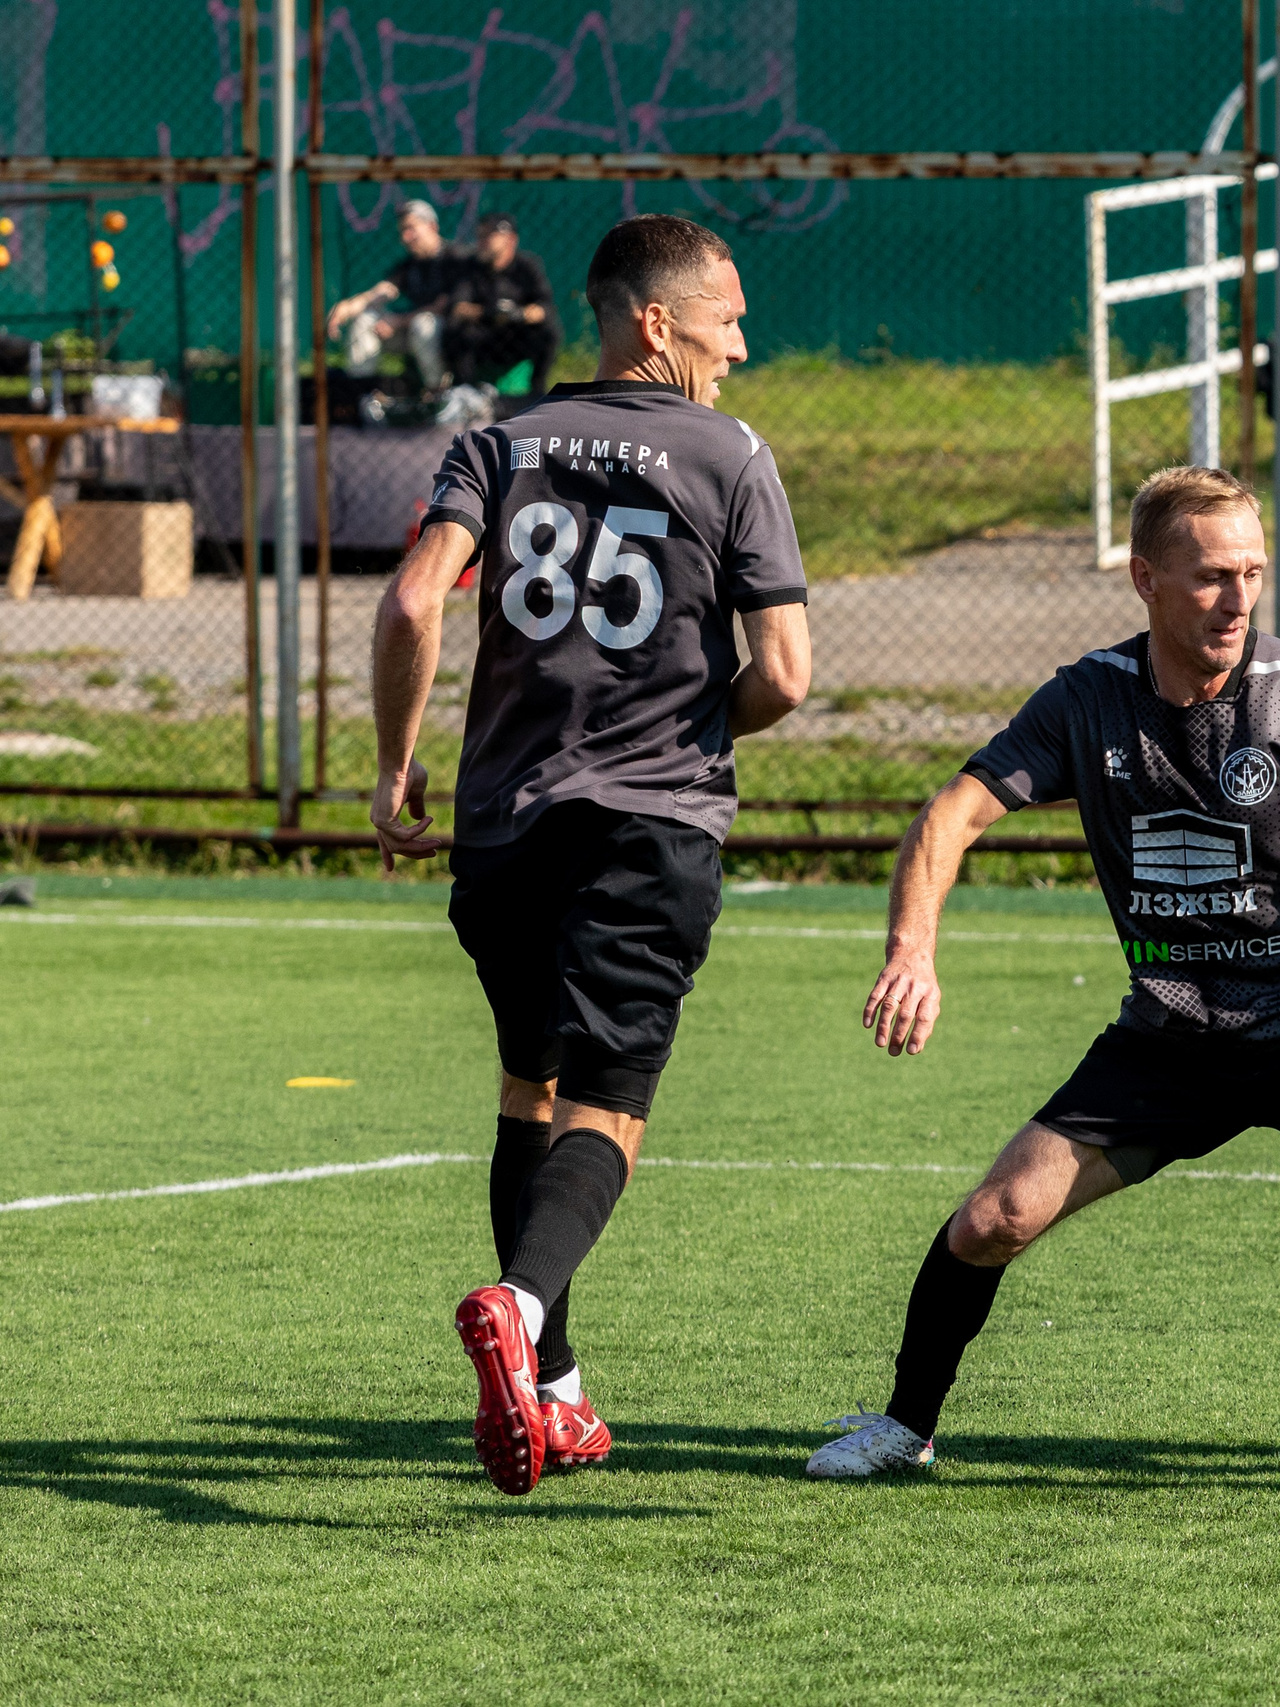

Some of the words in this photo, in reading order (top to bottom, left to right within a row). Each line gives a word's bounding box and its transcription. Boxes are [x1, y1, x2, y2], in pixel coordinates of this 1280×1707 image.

[548, 436, 669, 470] РИМЕРА
[570, 459, 647, 475] АЛНАС
[502, 501, 669, 649] 85
[1129, 887, 1258, 917] ЛЗЖБИ
